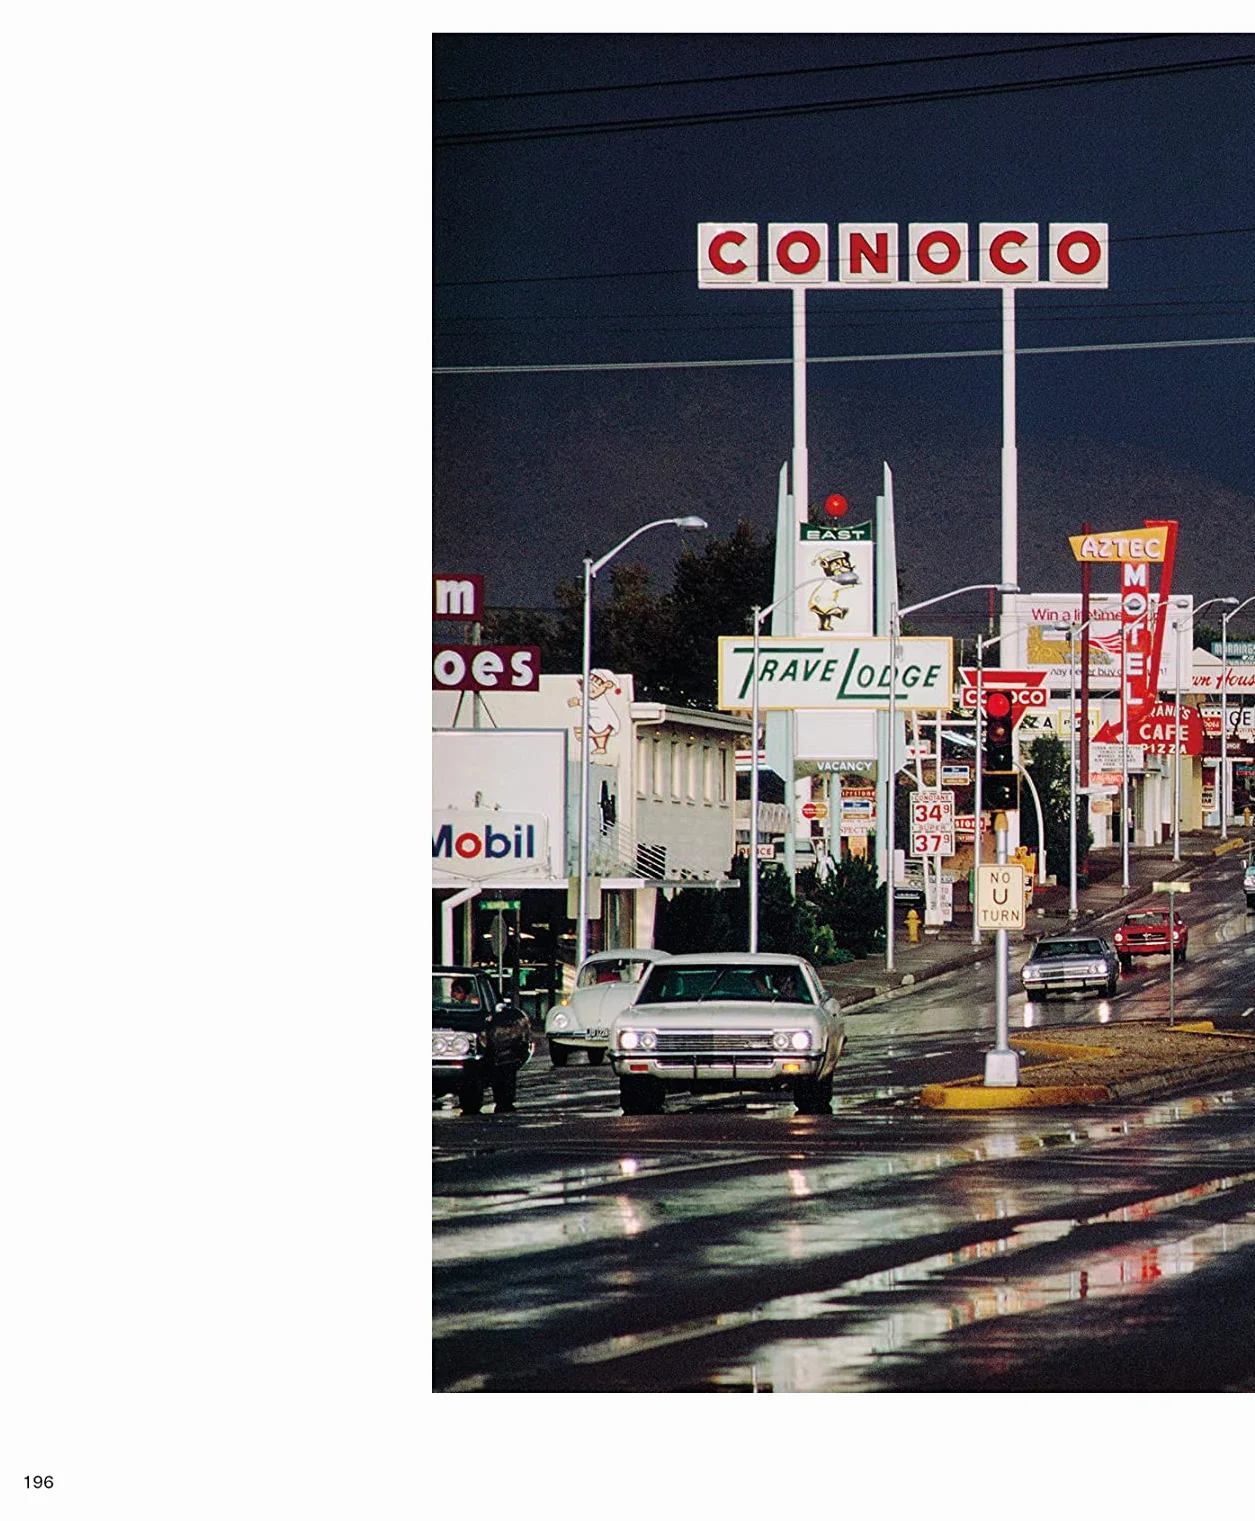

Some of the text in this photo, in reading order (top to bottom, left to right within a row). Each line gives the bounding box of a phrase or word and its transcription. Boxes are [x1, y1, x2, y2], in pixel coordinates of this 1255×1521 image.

[708, 230, 1101, 275] CONOCO
[806, 529, 866, 541] EAST
[1081, 536, 1161, 560] AZTEC
[1031, 608, 1060, 621] Win
[1123, 563, 1147, 705] MOTEL
[433, 649, 534, 687] oes
[1139, 723, 1189, 741] CAFE
[1142, 744, 1188, 754] PIZZA
[816, 761, 873, 772] VACANCY
[990, 872, 1011, 883] NO
[992, 888, 1009, 905] U
[981, 910, 1020, 922] TURN
